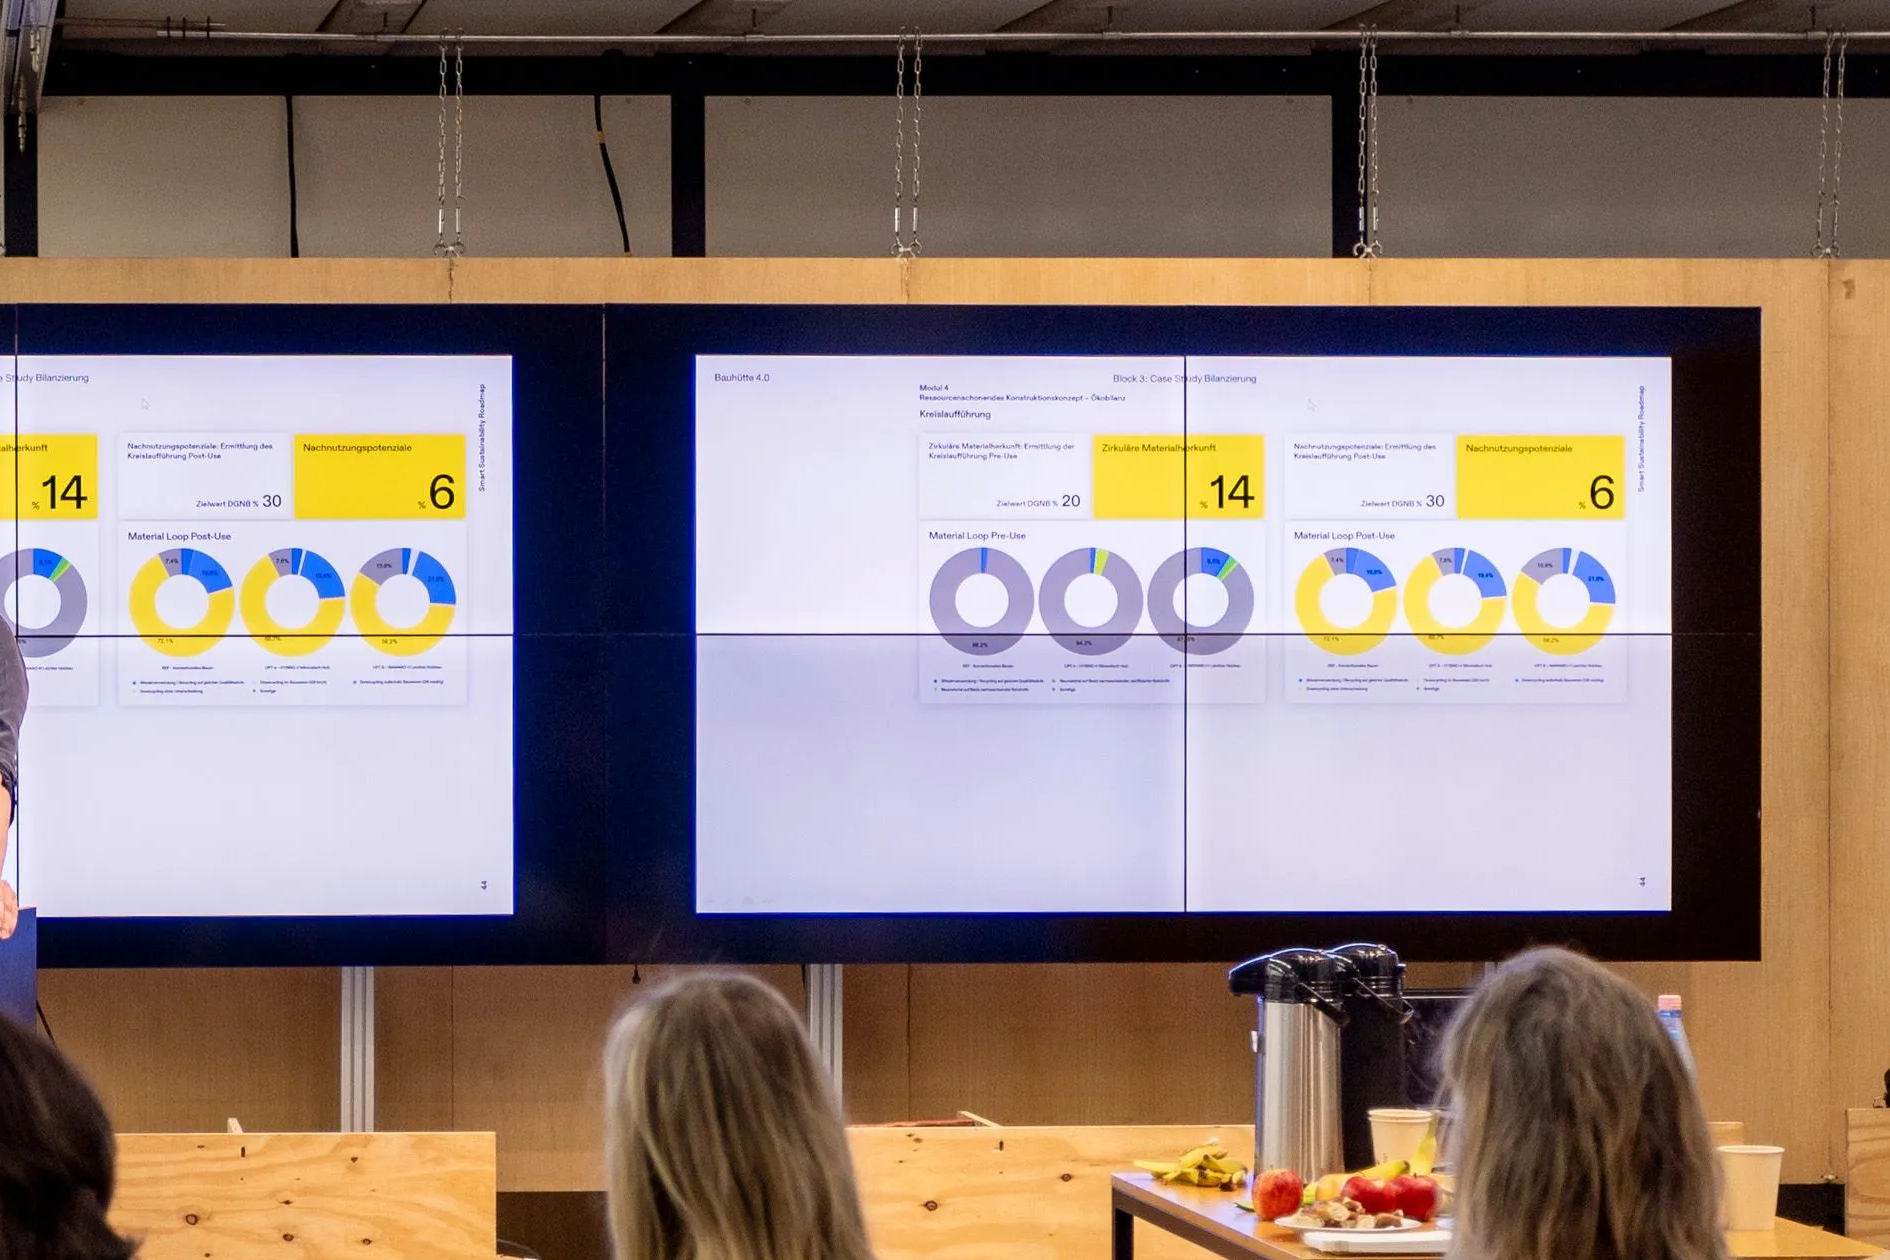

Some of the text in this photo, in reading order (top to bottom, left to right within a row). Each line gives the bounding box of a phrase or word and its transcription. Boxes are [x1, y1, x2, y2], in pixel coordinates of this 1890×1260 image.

[35, 373, 90, 383] Bilanzierung
[714, 373, 770, 382] Bauhütte 4.0
[1113, 374, 1139, 384] Block
[1140, 374, 1148, 384] 3:
[1150, 374, 1173, 384] Case
[1204, 374, 1257, 384] Bilanzierung
[919, 384, 950, 392] Modul 4
[478, 383, 486, 418] Roadmap
[919, 392, 1126, 403] Ressourcenschonendes Konstruktionskonzept Ökobilanz
[1638, 385, 1646, 420] Roadmap
[919, 409, 991, 420] Kreislaufführung
[127, 442, 273, 452] Nachnutzungspotenziale: Ermittlung des
[303, 443, 412, 454] Nachnutzungspotenziale
[478, 420, 486, 468] Sustainability
[928, 442, 960, 451] Zirkuläre
[1024, 442, 1061, 451] Ermittlung
[1063, 442, 1075, 451] der
[1102, 443, 1140, 453] Zirkuläre
[1385, 442, 1422, 452] Ermittlung
[1423, 442, 1437, 452] des
[1466, 444, 1573, 454] Nachnutzungspotenziale
[1638, 421, 1646, 469] Sustainability
[127, 453, 221, 461] Kreislaufführung Post-Use
[928, 452, 1018, 461] Kreislaufführung Pre-Use
[1293, 452, 1387, 461] Kreislaufführung Post-Use
[31, 474, 88, 510] % 14
[417, 473, 455, 510] % 6
[1210, 473, 1255, 509] 14
[1578, 474, 1615, 510] % 6
[196, 500, 225, 508] Zielwert
[227, 500, 251, 508] DGNB
[262, 494, 282, 508] 30
[996, 499, 1026, 508] Zielwert
[1027, 499, 1051, 508] DGNB
[1062, 493, 1082, 508] 20
[1360, 500, 1390, 508] Zielwert
[1391, 500, 1414, 508] DGNB
[1425, 494, 1445, 508] 30
[127, 531, 232, 543] Material Loop Post-Use
[928, 531, 1027, 542] Material Loop Pre-Use
[1294, 532, 1396, 542] Material Loop Post-Use
